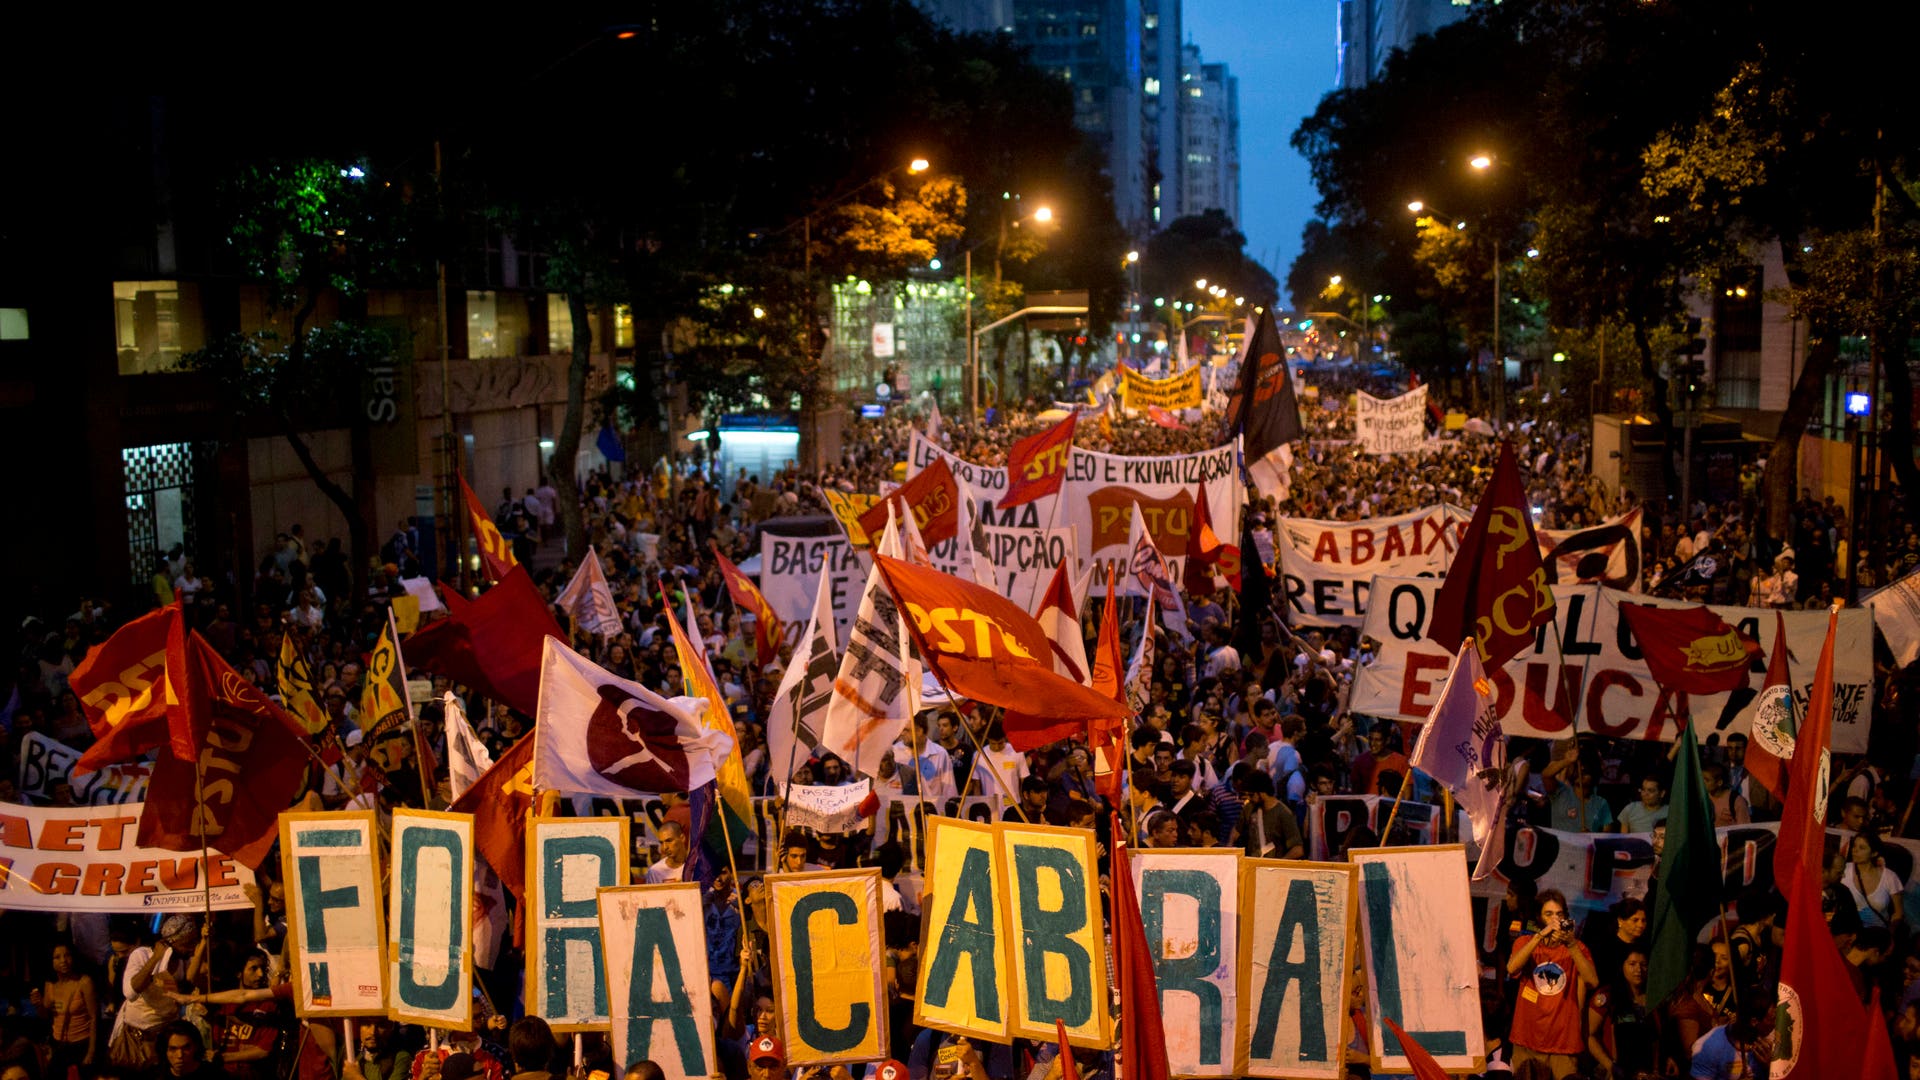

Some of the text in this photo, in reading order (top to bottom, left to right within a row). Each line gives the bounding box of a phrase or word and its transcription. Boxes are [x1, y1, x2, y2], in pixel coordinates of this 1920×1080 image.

[981, 469, 1005, 489] DO
[1105, 459, 1116, 482] E
[771, 541, 860, 575] BASTA
[1476, 567, 1555, 663] PCB
[31, 856, 240, 896] GREVE
